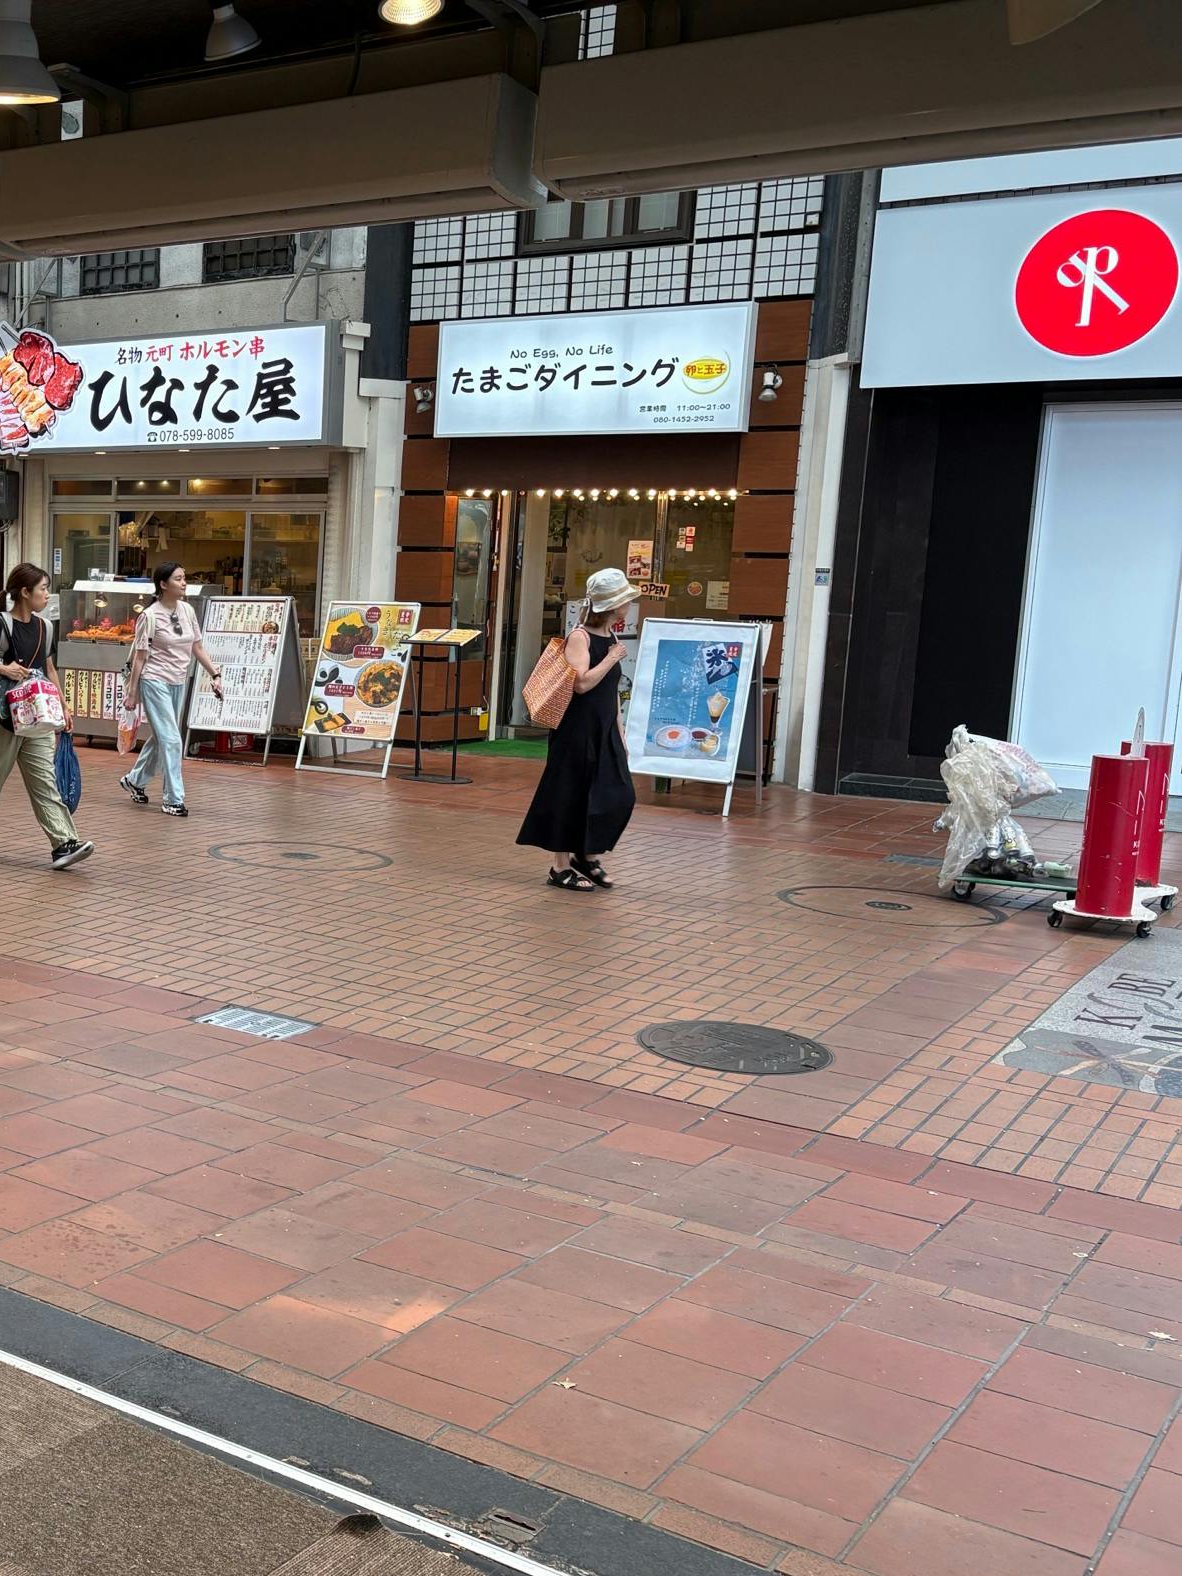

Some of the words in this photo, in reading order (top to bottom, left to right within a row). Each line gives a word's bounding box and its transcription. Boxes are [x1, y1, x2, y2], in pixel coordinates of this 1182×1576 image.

[115, 346, 143, 365] 名物
[145, 344, 174, 363] 元町
[179, 336, 266, 361] ホルモン串
[510, 350, 527, 360] No
[533, 348, 559, 359] Egg,
[566, 347, 583, 357] No
[589, 344, 613, 355] Life
[451, 356, 680, 395] たまごダイニング
[685, 363, 727, 376] 卵と玉子
[88, 358, 301, 432] ひなた屋
[639, 404, 667, 413] 営業時間
[653, 415, 715, 424] 080-1452-2952
[159, 428, 235, 442] 078-599-8085
[641, 583, 668, 595] OPEN
[705, 648, 729, 669] 氷
